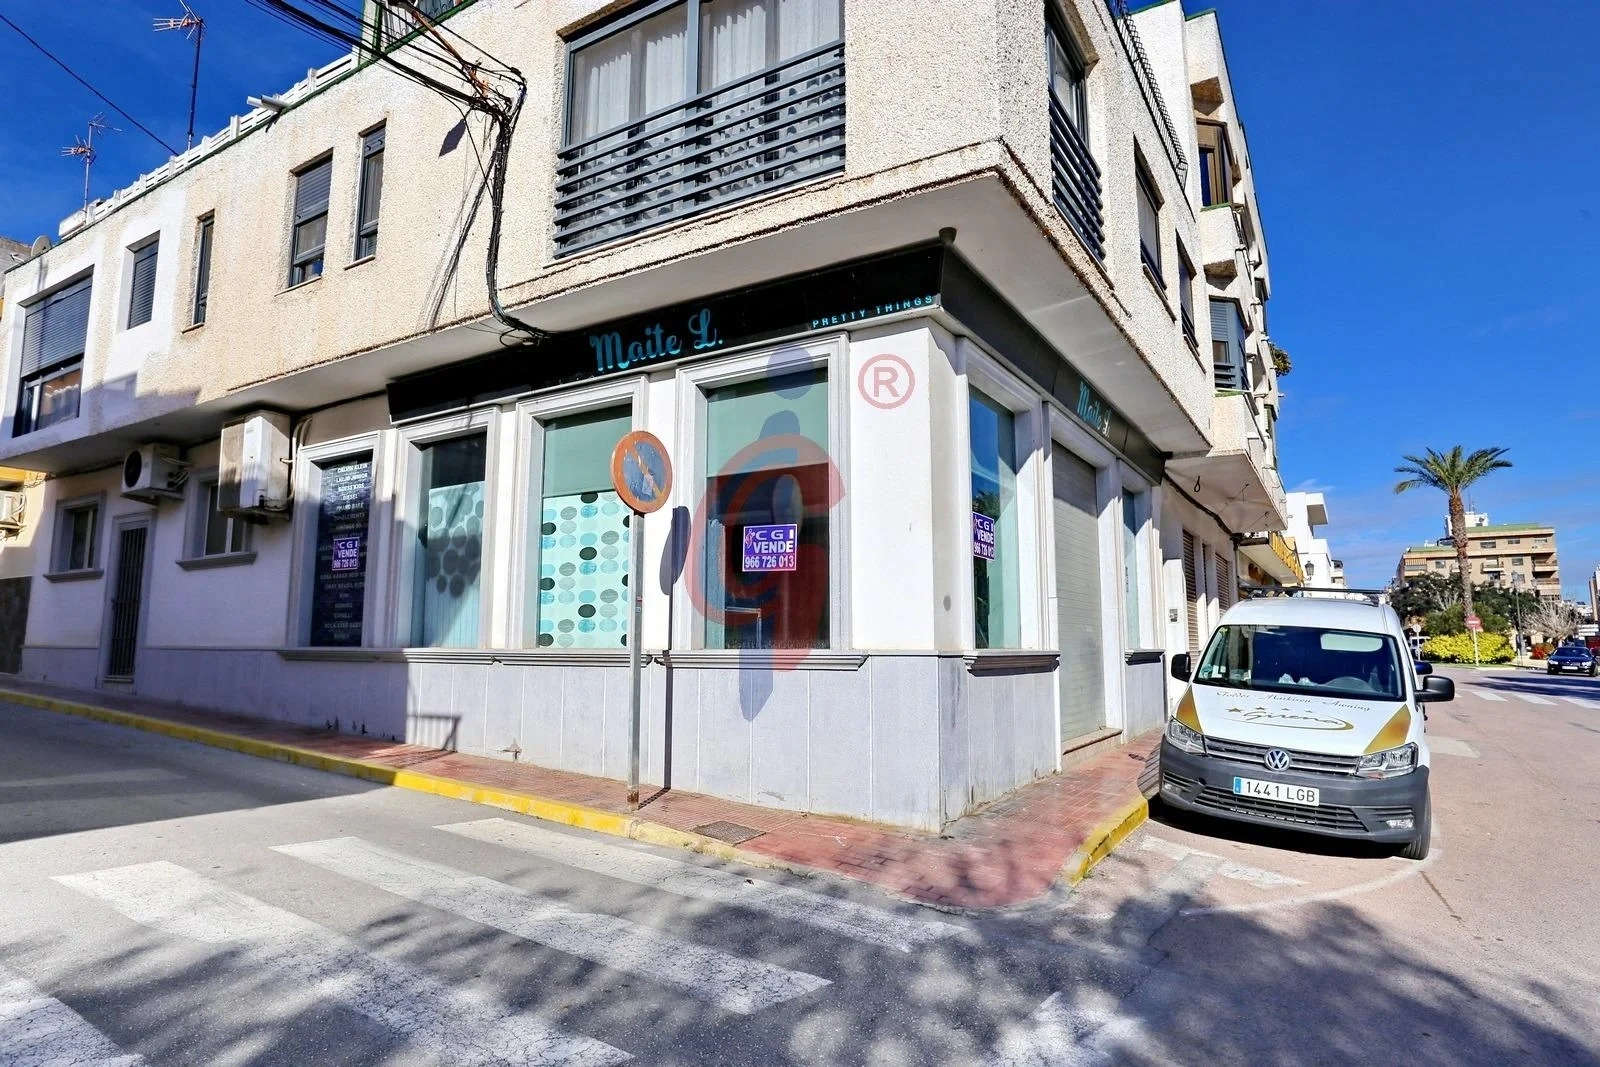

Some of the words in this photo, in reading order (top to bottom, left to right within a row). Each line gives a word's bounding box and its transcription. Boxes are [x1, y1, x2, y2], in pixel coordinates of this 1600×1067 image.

[812, 308, 867, 329] PRETTY
[875, 294, 936, 315] THINGS
[589, 322, 682, 373] Maite
[976, 528, 995, 545] VENDE
[337, 548, 358, 558] VENDE
[752, 540, 795, 554] VENDE
[744, 556, 760, 569] 966
[761, 555, 777, 568] 726
[778, 555, 795, 568] 013
[1246, 780, 1281, 799] 1441
[1286, 786, 1316, 804] LGB
